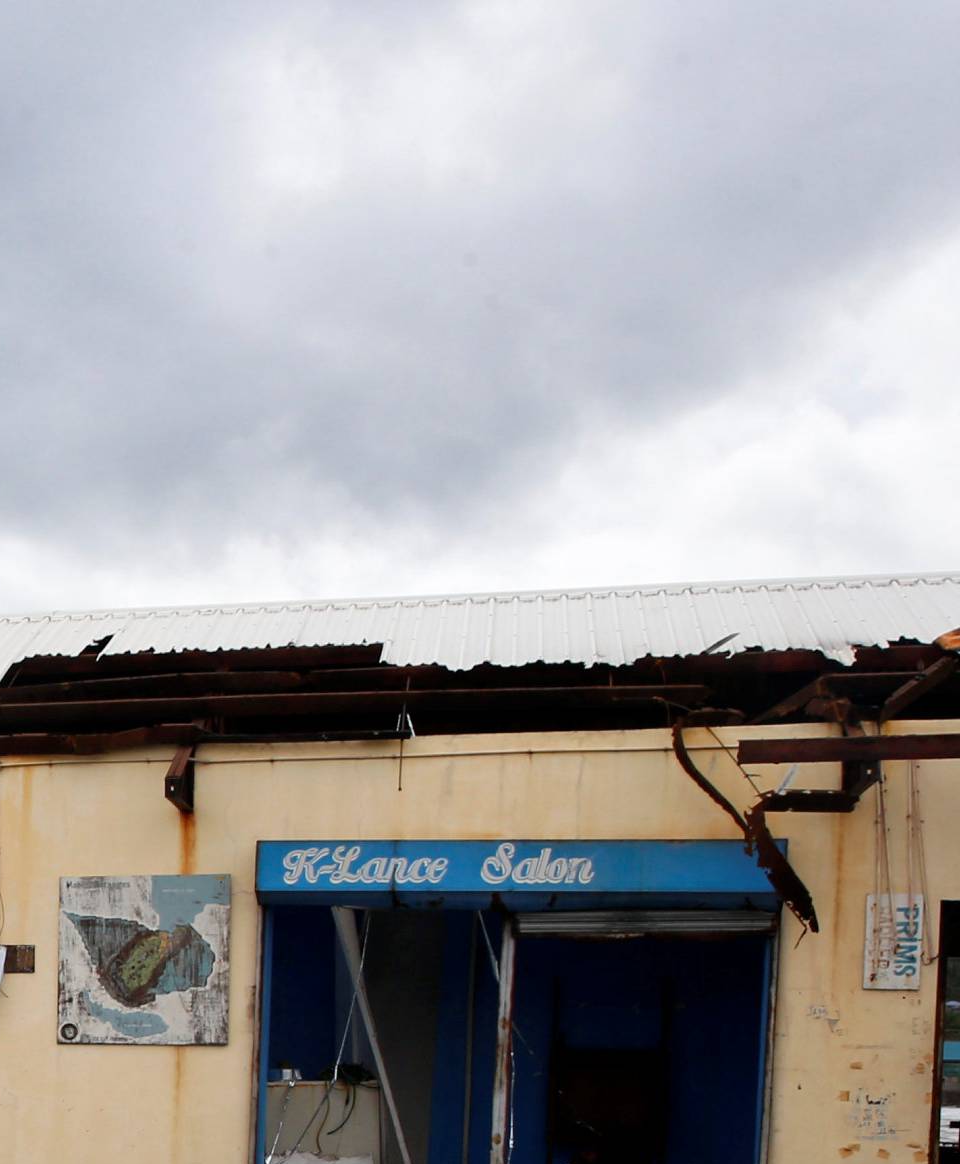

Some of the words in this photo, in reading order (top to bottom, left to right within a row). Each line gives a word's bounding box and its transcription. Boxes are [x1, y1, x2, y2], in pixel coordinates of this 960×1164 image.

[283, 846, 448, 884] K-Lance
[480, 842, 595, 884] Salon
[894, 907, 920, 976] PRIMS
